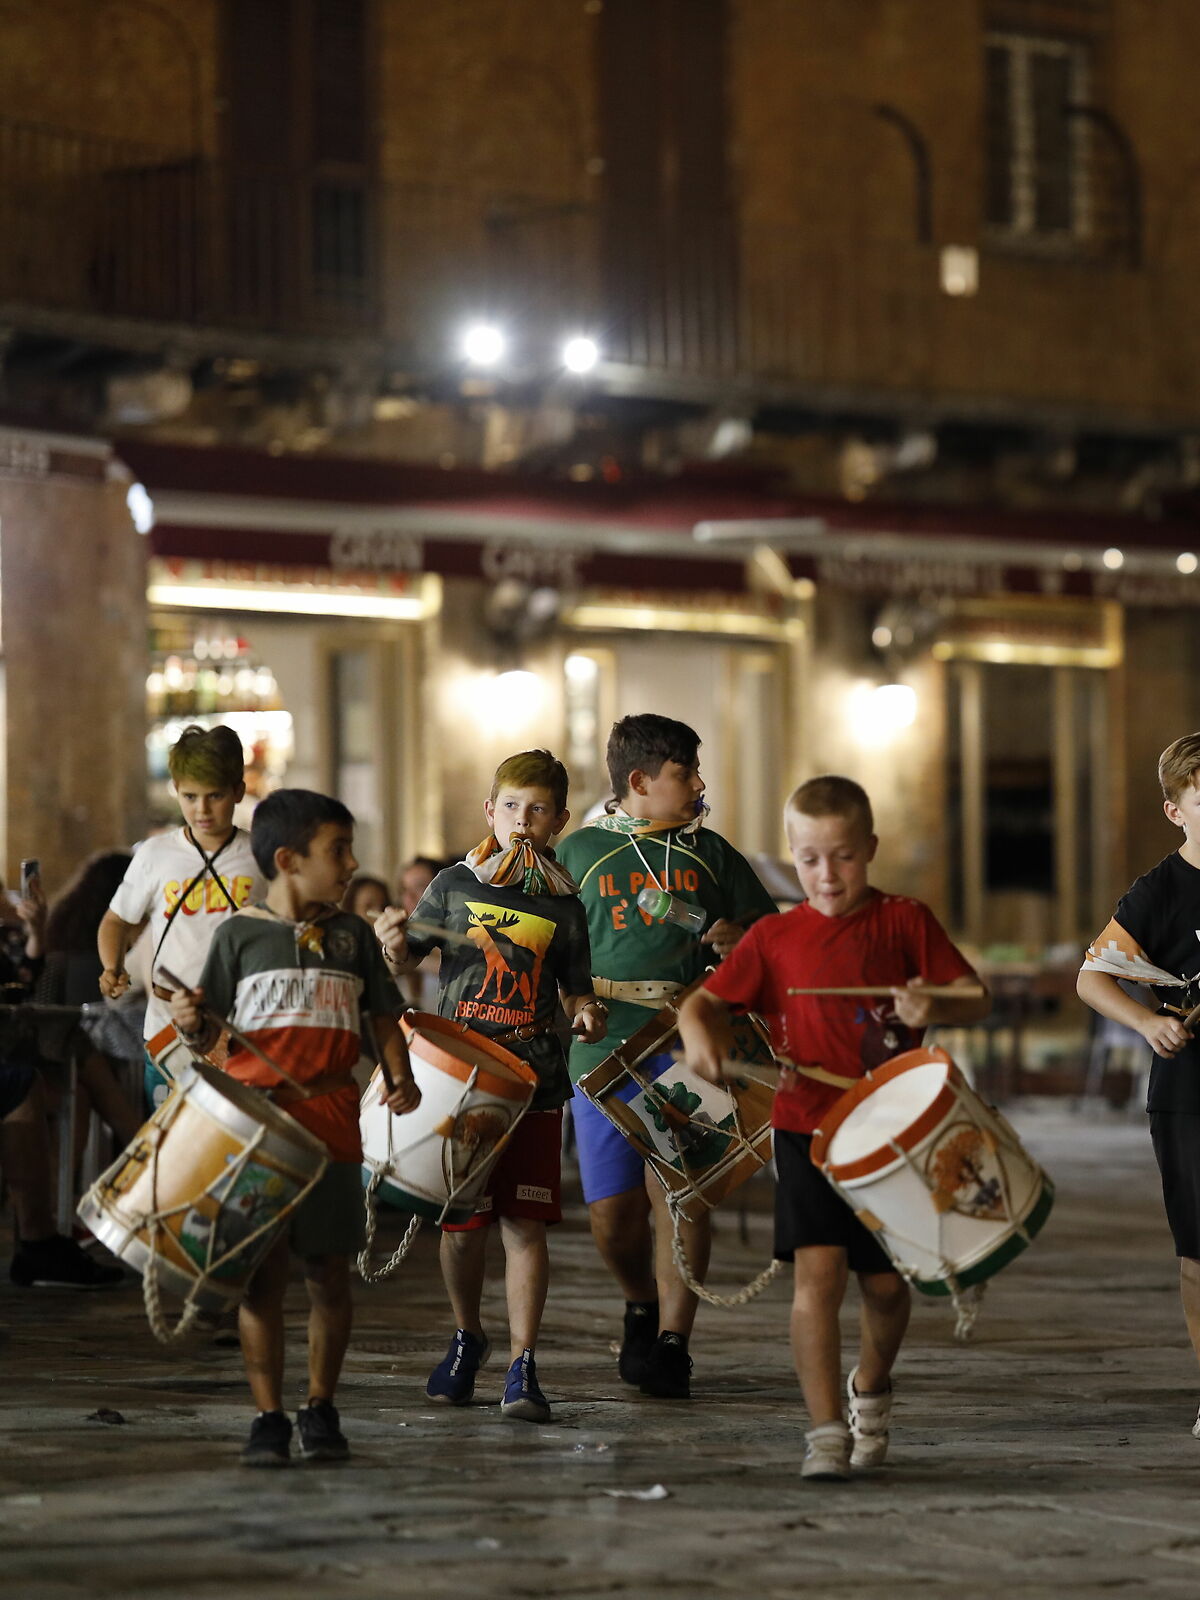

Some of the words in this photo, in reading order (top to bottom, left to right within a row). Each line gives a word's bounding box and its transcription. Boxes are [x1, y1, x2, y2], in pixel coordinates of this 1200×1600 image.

[599, 873, 621, 897] IL
[629, 869, 698, 894] PALIO
[521, 1187, 550, 1200] street
